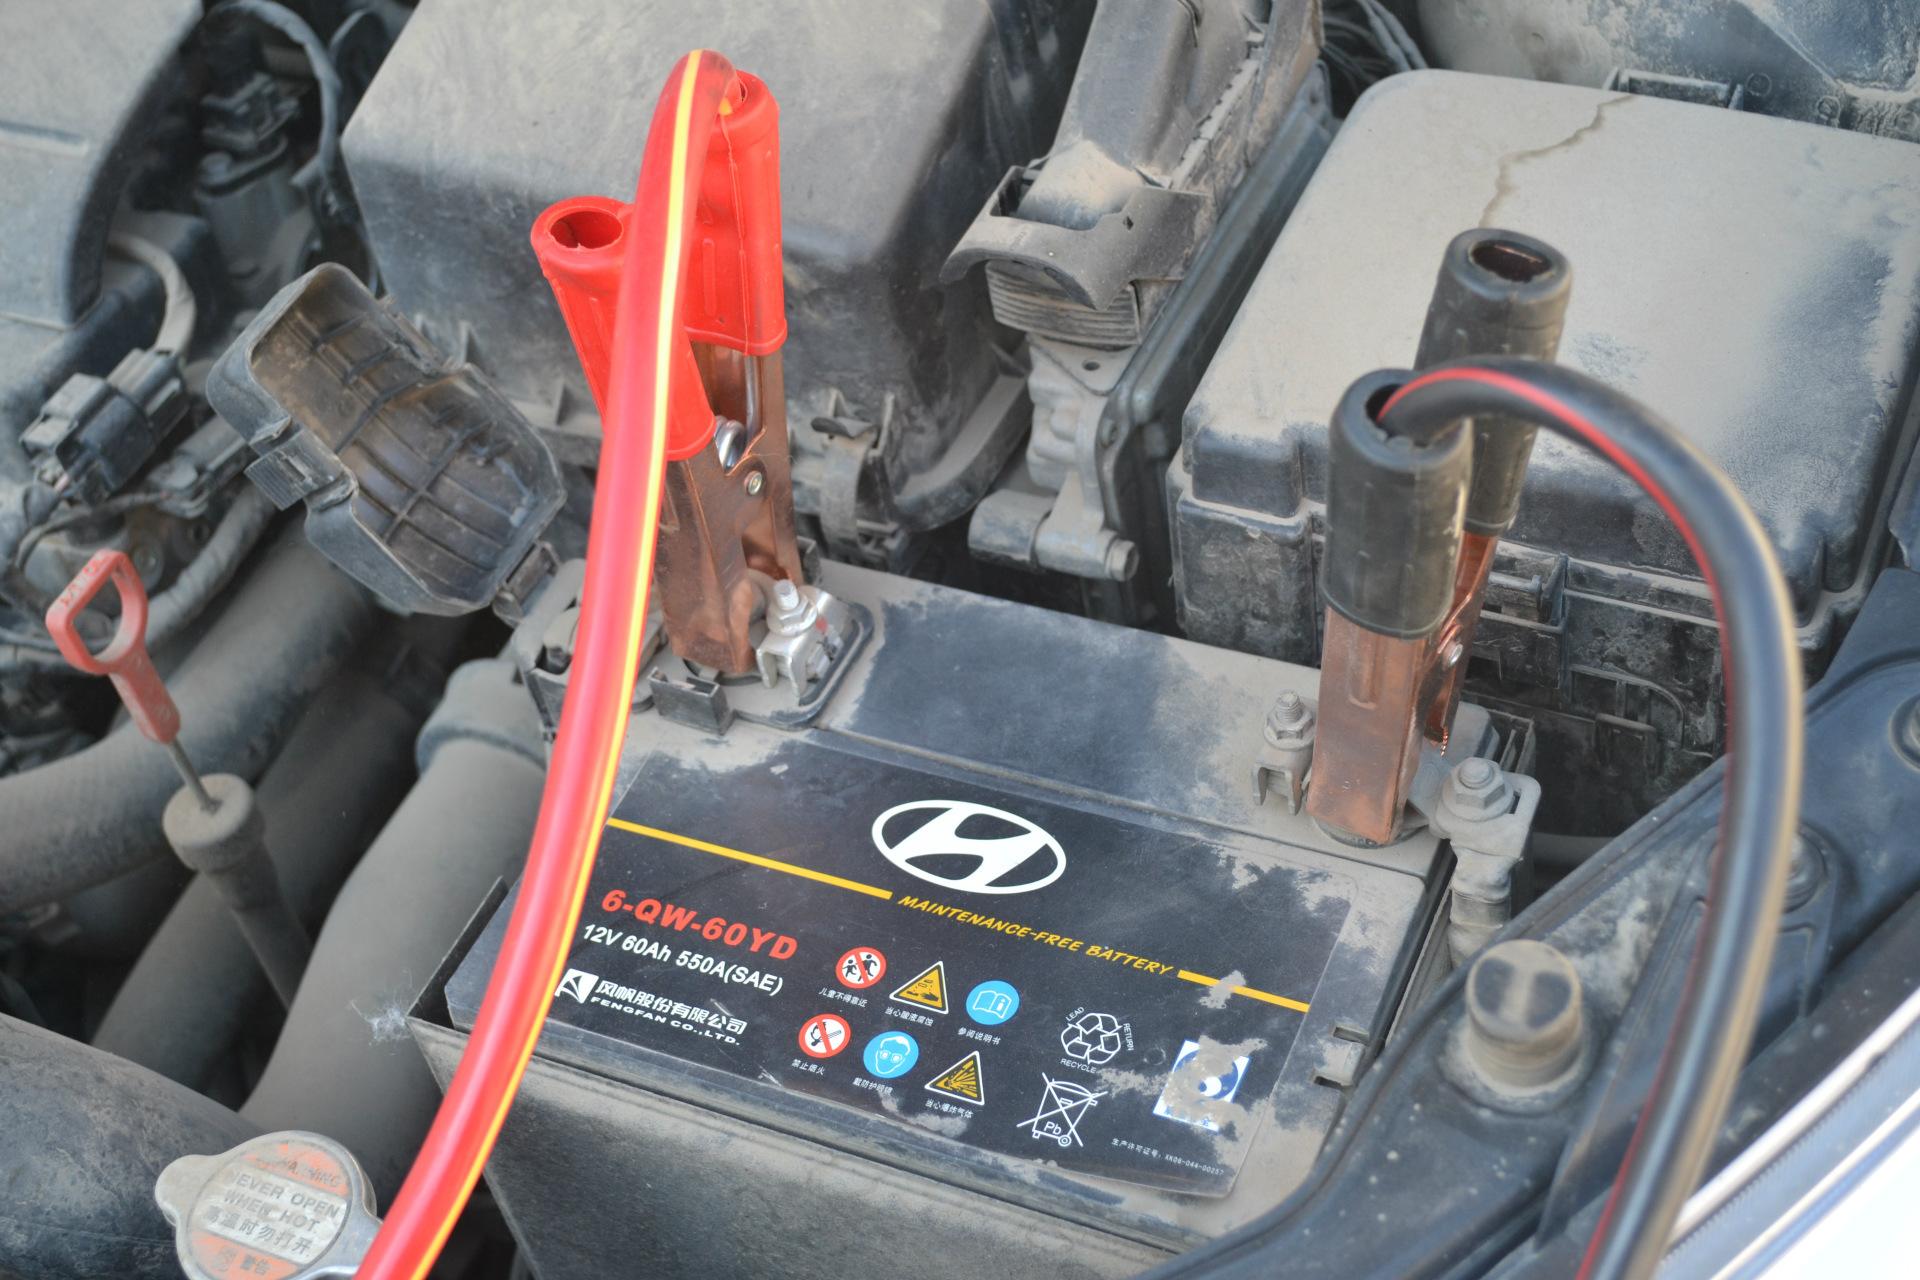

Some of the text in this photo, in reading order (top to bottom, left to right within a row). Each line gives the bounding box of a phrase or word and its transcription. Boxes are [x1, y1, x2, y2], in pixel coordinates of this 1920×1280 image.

[601, 889, 798, 960] 6-QW-60YD
[898, 896, 1174, 976] MAINTENANCE-FREE BATTERY
[583, 924, 784, 996] 12V 60Ah 550A(SAE)
[591, 996, 667, 1024] FENGFAN
[597, 980, 748, 1035] 风帆股份有限公司
[1065, 1006, 1085, 1021] LEAD
[1123, 1022, 1135, 1051] RETURN
[1060, 1058, 1097, 1074] RECYCLE
[1043, 1120, 1062, 1136] Pb
[290, 1192, 340, 1218] OPEN
